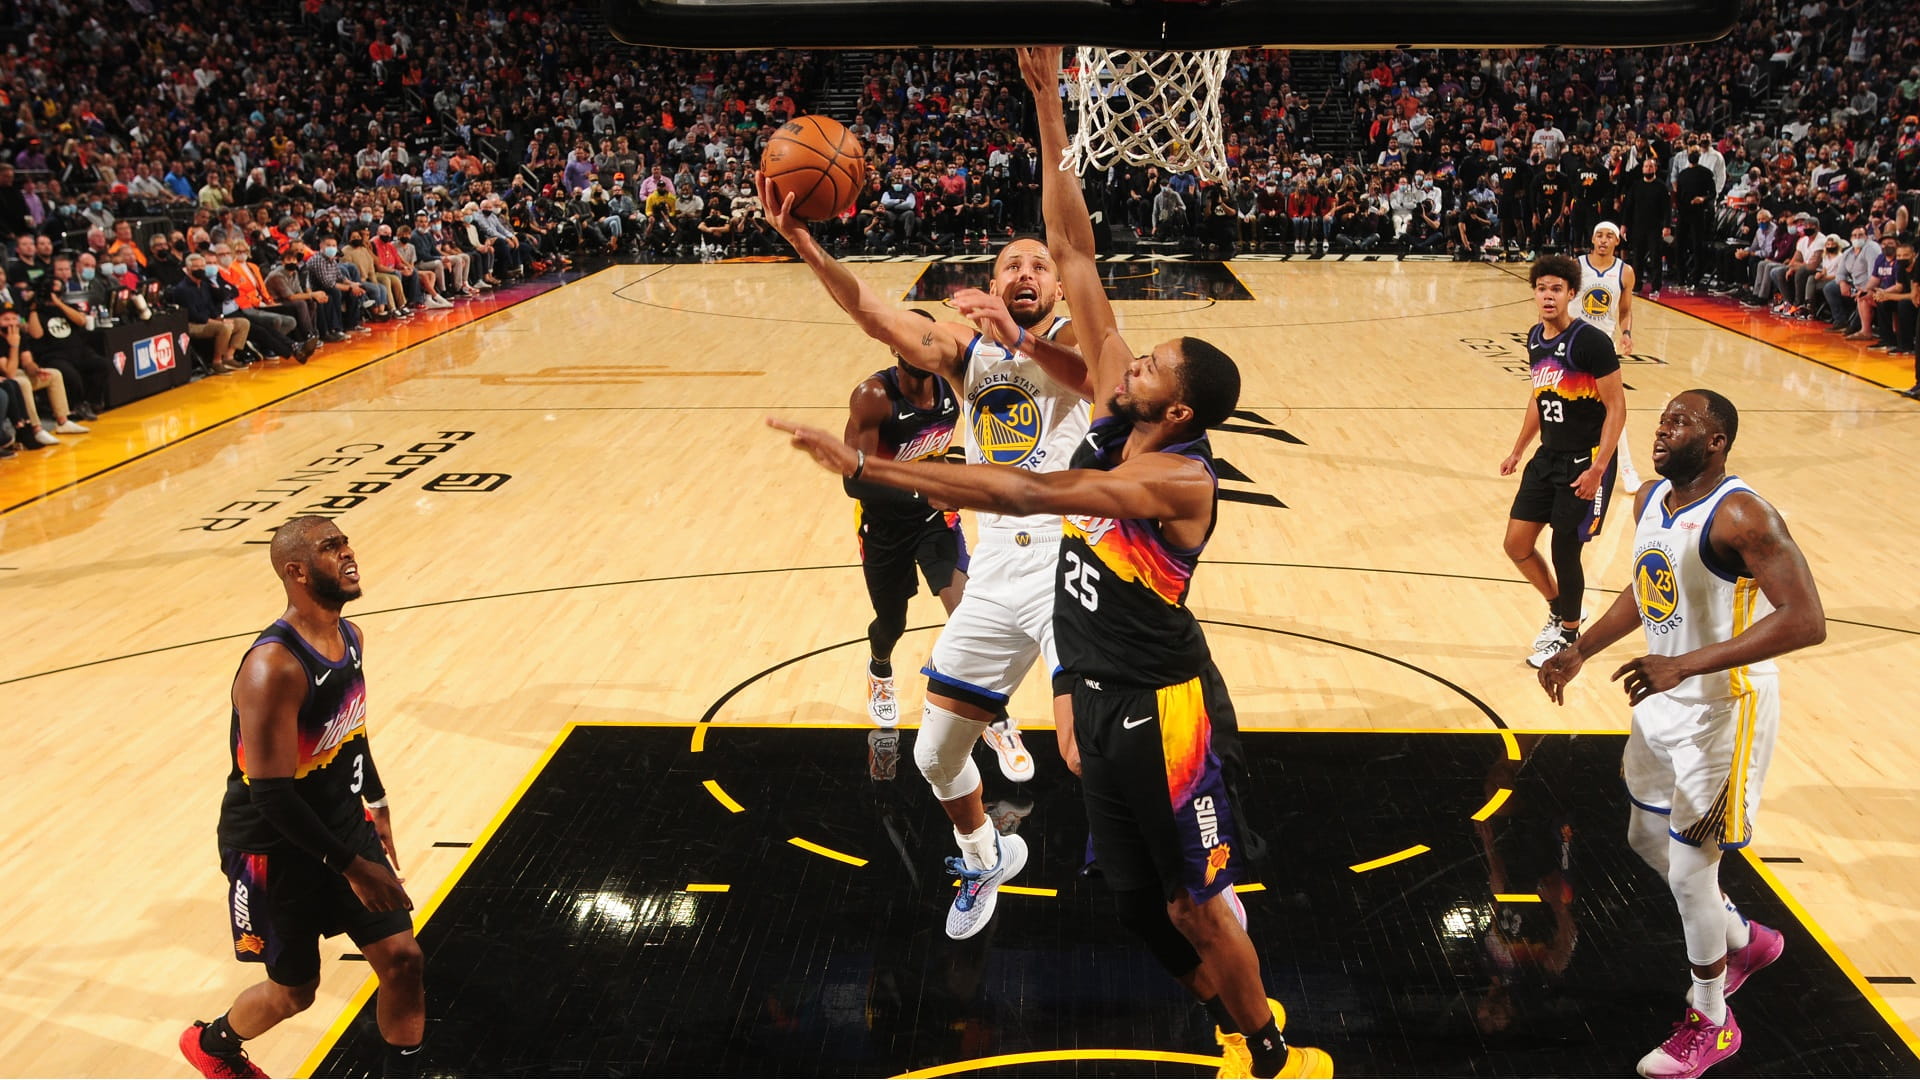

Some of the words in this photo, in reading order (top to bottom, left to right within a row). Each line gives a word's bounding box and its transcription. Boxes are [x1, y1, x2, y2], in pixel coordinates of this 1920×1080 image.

[836, 254, 1191, 262] PHOIX
[1601, 294, 1607, 303] 3
[967, 373, 1008, 401] GOLDEN
[1013, 375, 1041, 397] STATE
[1006, 403, 1033, 427] 30
[1541, 400, 1564, 423] 23
[179, 443, 385, 532] CENTER
[1064, 550, 1101, 613] 25
[1655, 569, 1672, 592] 23
[350, 753, 364, 794] 3
[1193, 795, 1220, 849] SUNS
[234, 879, 252, 931] SUNS
